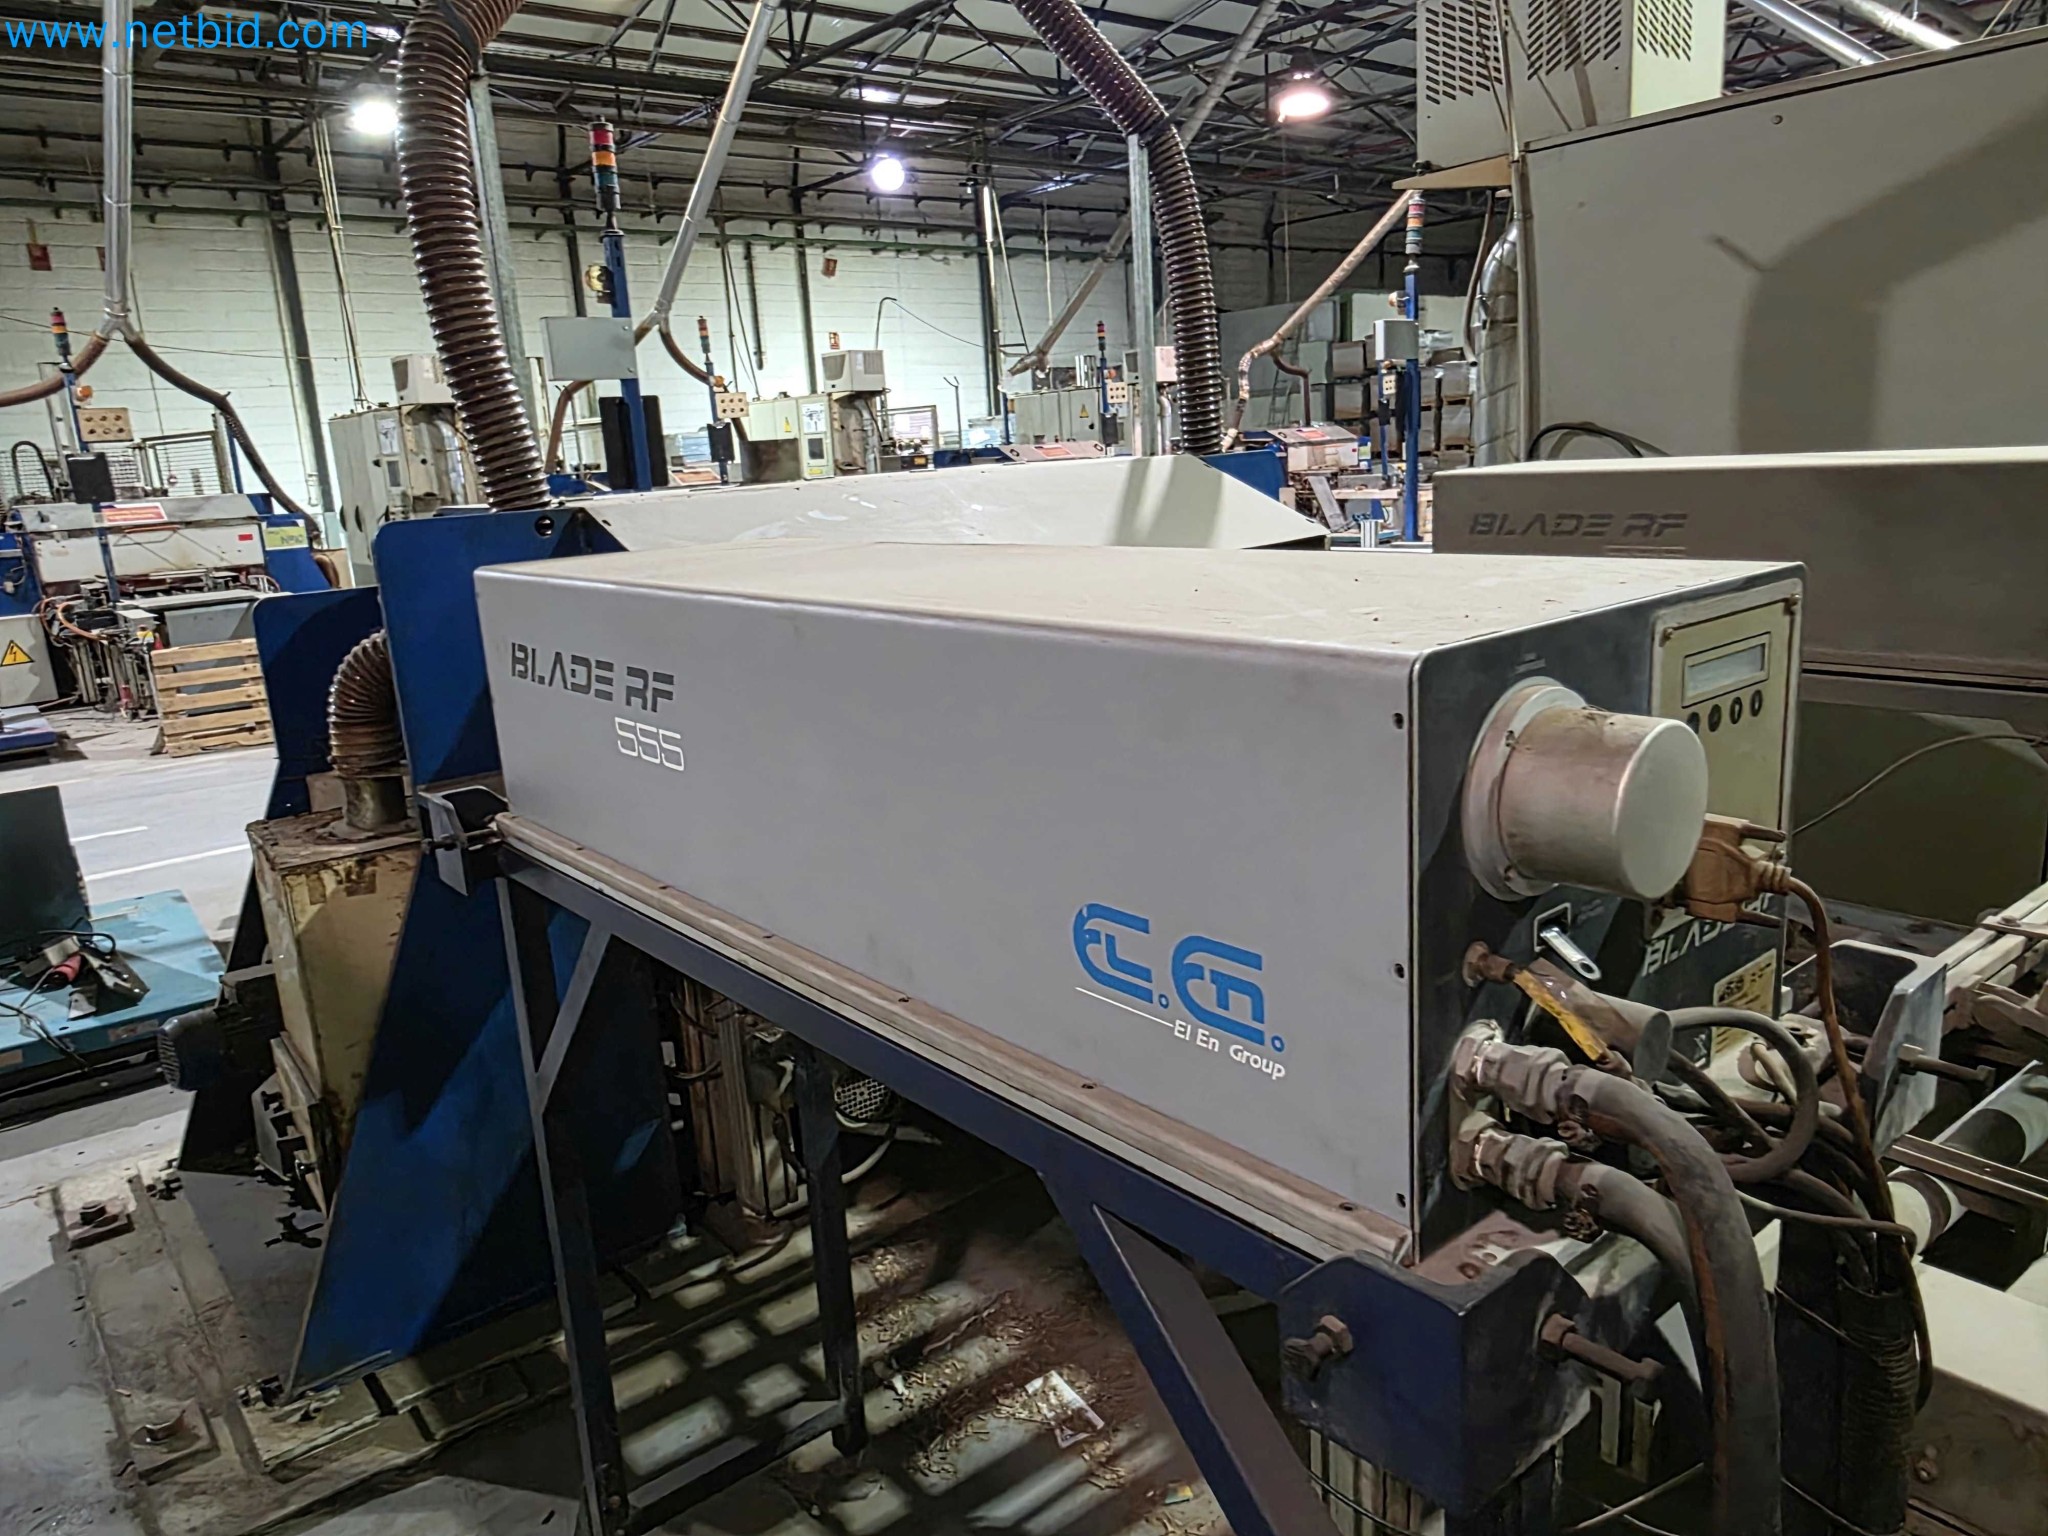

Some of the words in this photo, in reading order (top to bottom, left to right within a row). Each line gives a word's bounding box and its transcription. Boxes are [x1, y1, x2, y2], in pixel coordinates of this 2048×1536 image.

[1469, 512, 1614, 537] BLADE
[1621, 512, 1688, 537] RF
[511, 642, 614, 702] BLADE
[625, 665, 675, 713] RF
[614, 716, 685, 772] 555
[1173, 1018, 1192, 1041] El
[1196, 1027, 1220, 1052] En
[1229, 1043, 1286, 1080] Group
